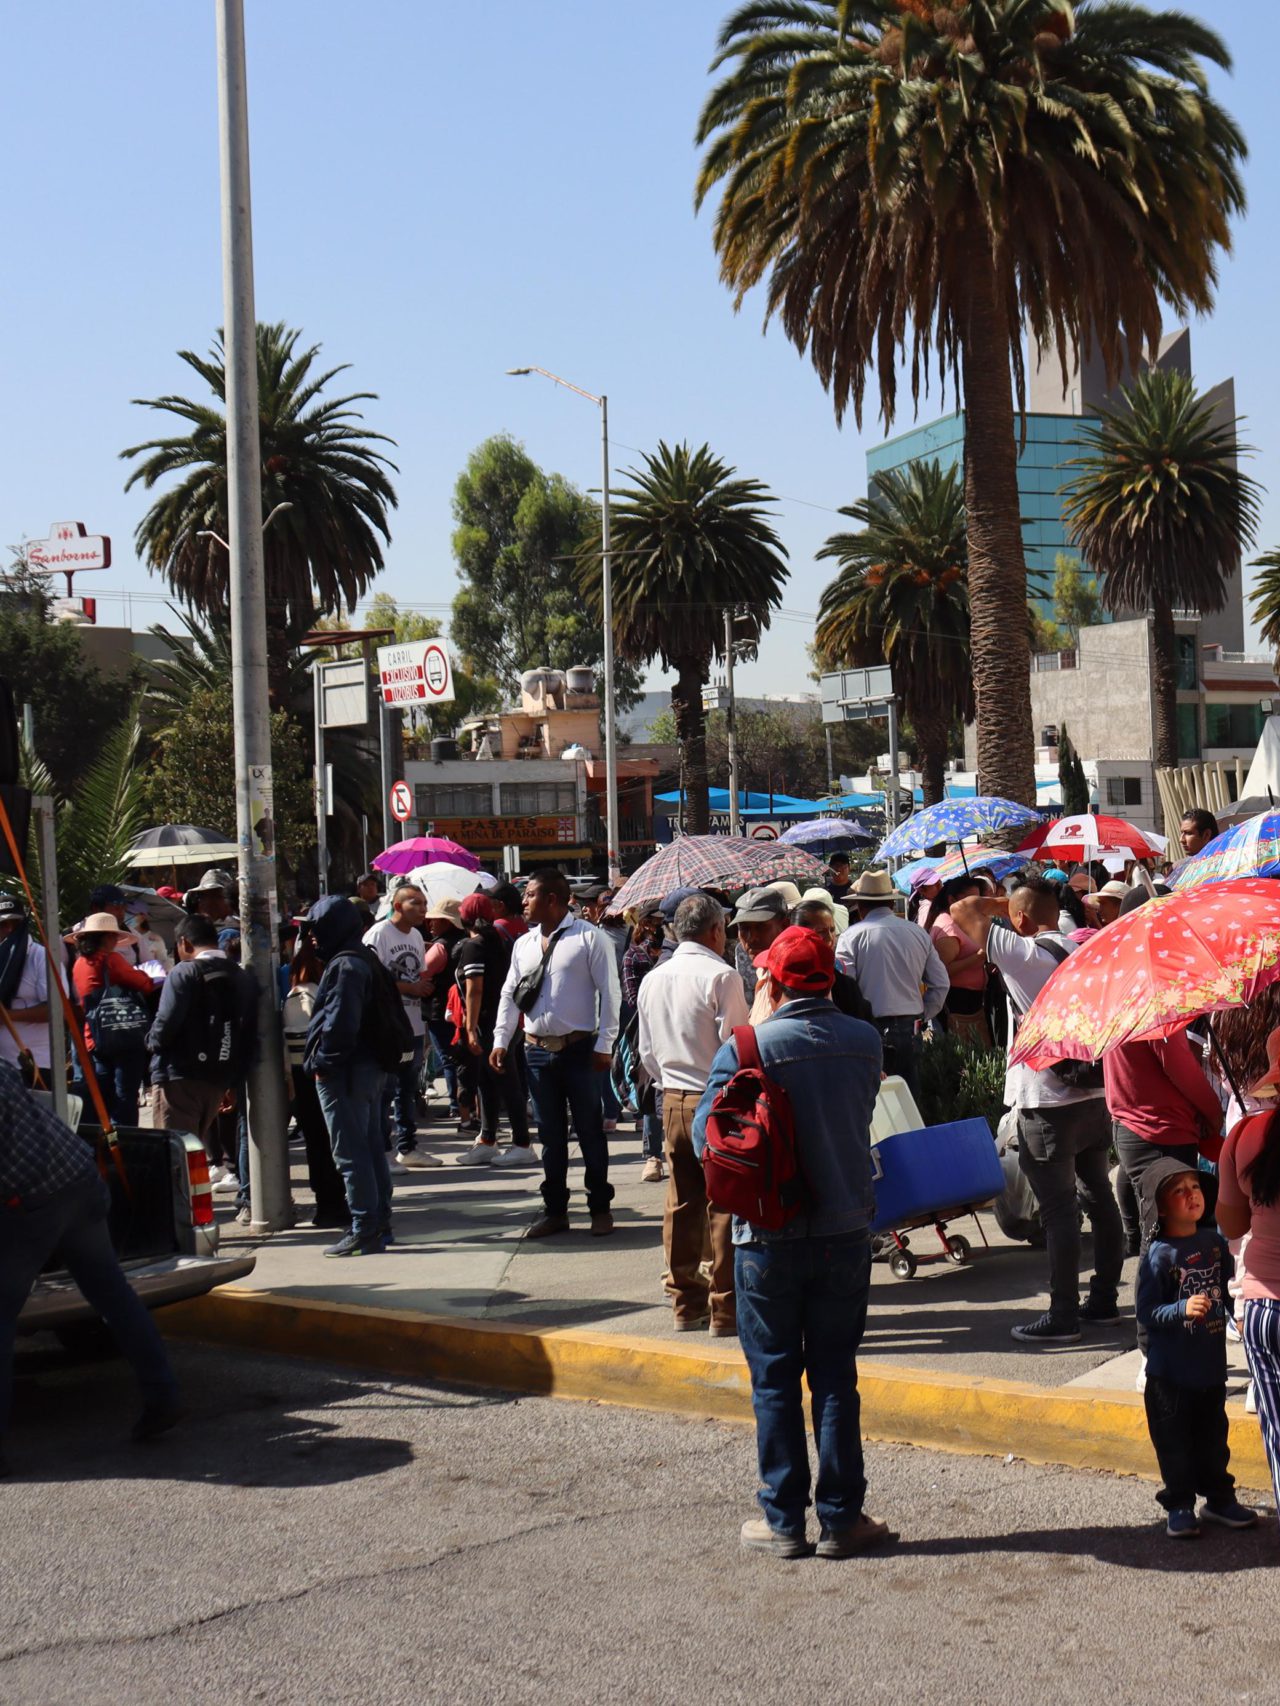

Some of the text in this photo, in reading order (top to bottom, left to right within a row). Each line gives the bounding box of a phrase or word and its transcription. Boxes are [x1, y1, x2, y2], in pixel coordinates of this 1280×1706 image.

[29, 548, 101, 564] Sanborns
[387, 650, 413, 666] CARRIL
[385, 665, 419, 683] EXCLUSIVO
[389, 685, 420, 702] TUZOBUS
[460, 818, 538, 830] PASTES
[492, 828, 506, 840] DE
[219, 1020, 231, 1061] Wilson
